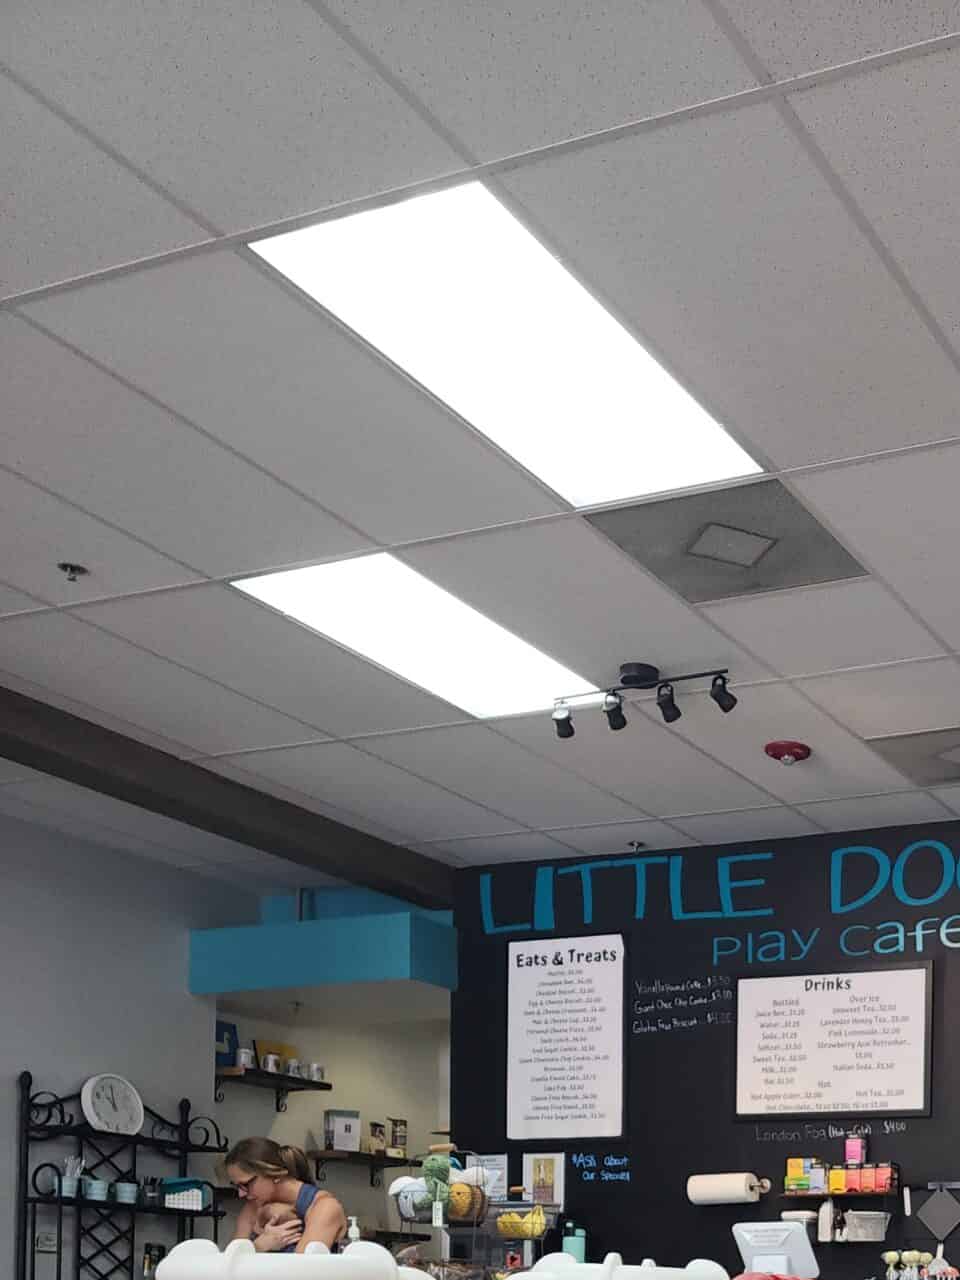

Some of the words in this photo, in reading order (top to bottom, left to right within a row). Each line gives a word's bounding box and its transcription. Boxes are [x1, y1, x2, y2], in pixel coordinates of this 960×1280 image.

[480, 852, 775, 934] LITTLE
[712, 927, 821, 967] Play
[515, 953, 548, 968] Eats
[551, 951, 564, 966] &
[567, 948, 617, 964] Treats
[803, 976, 852, 992] Drinks
[756, 1124, 802, 1141] London
[804, 1123, 826, 1141] Fog
